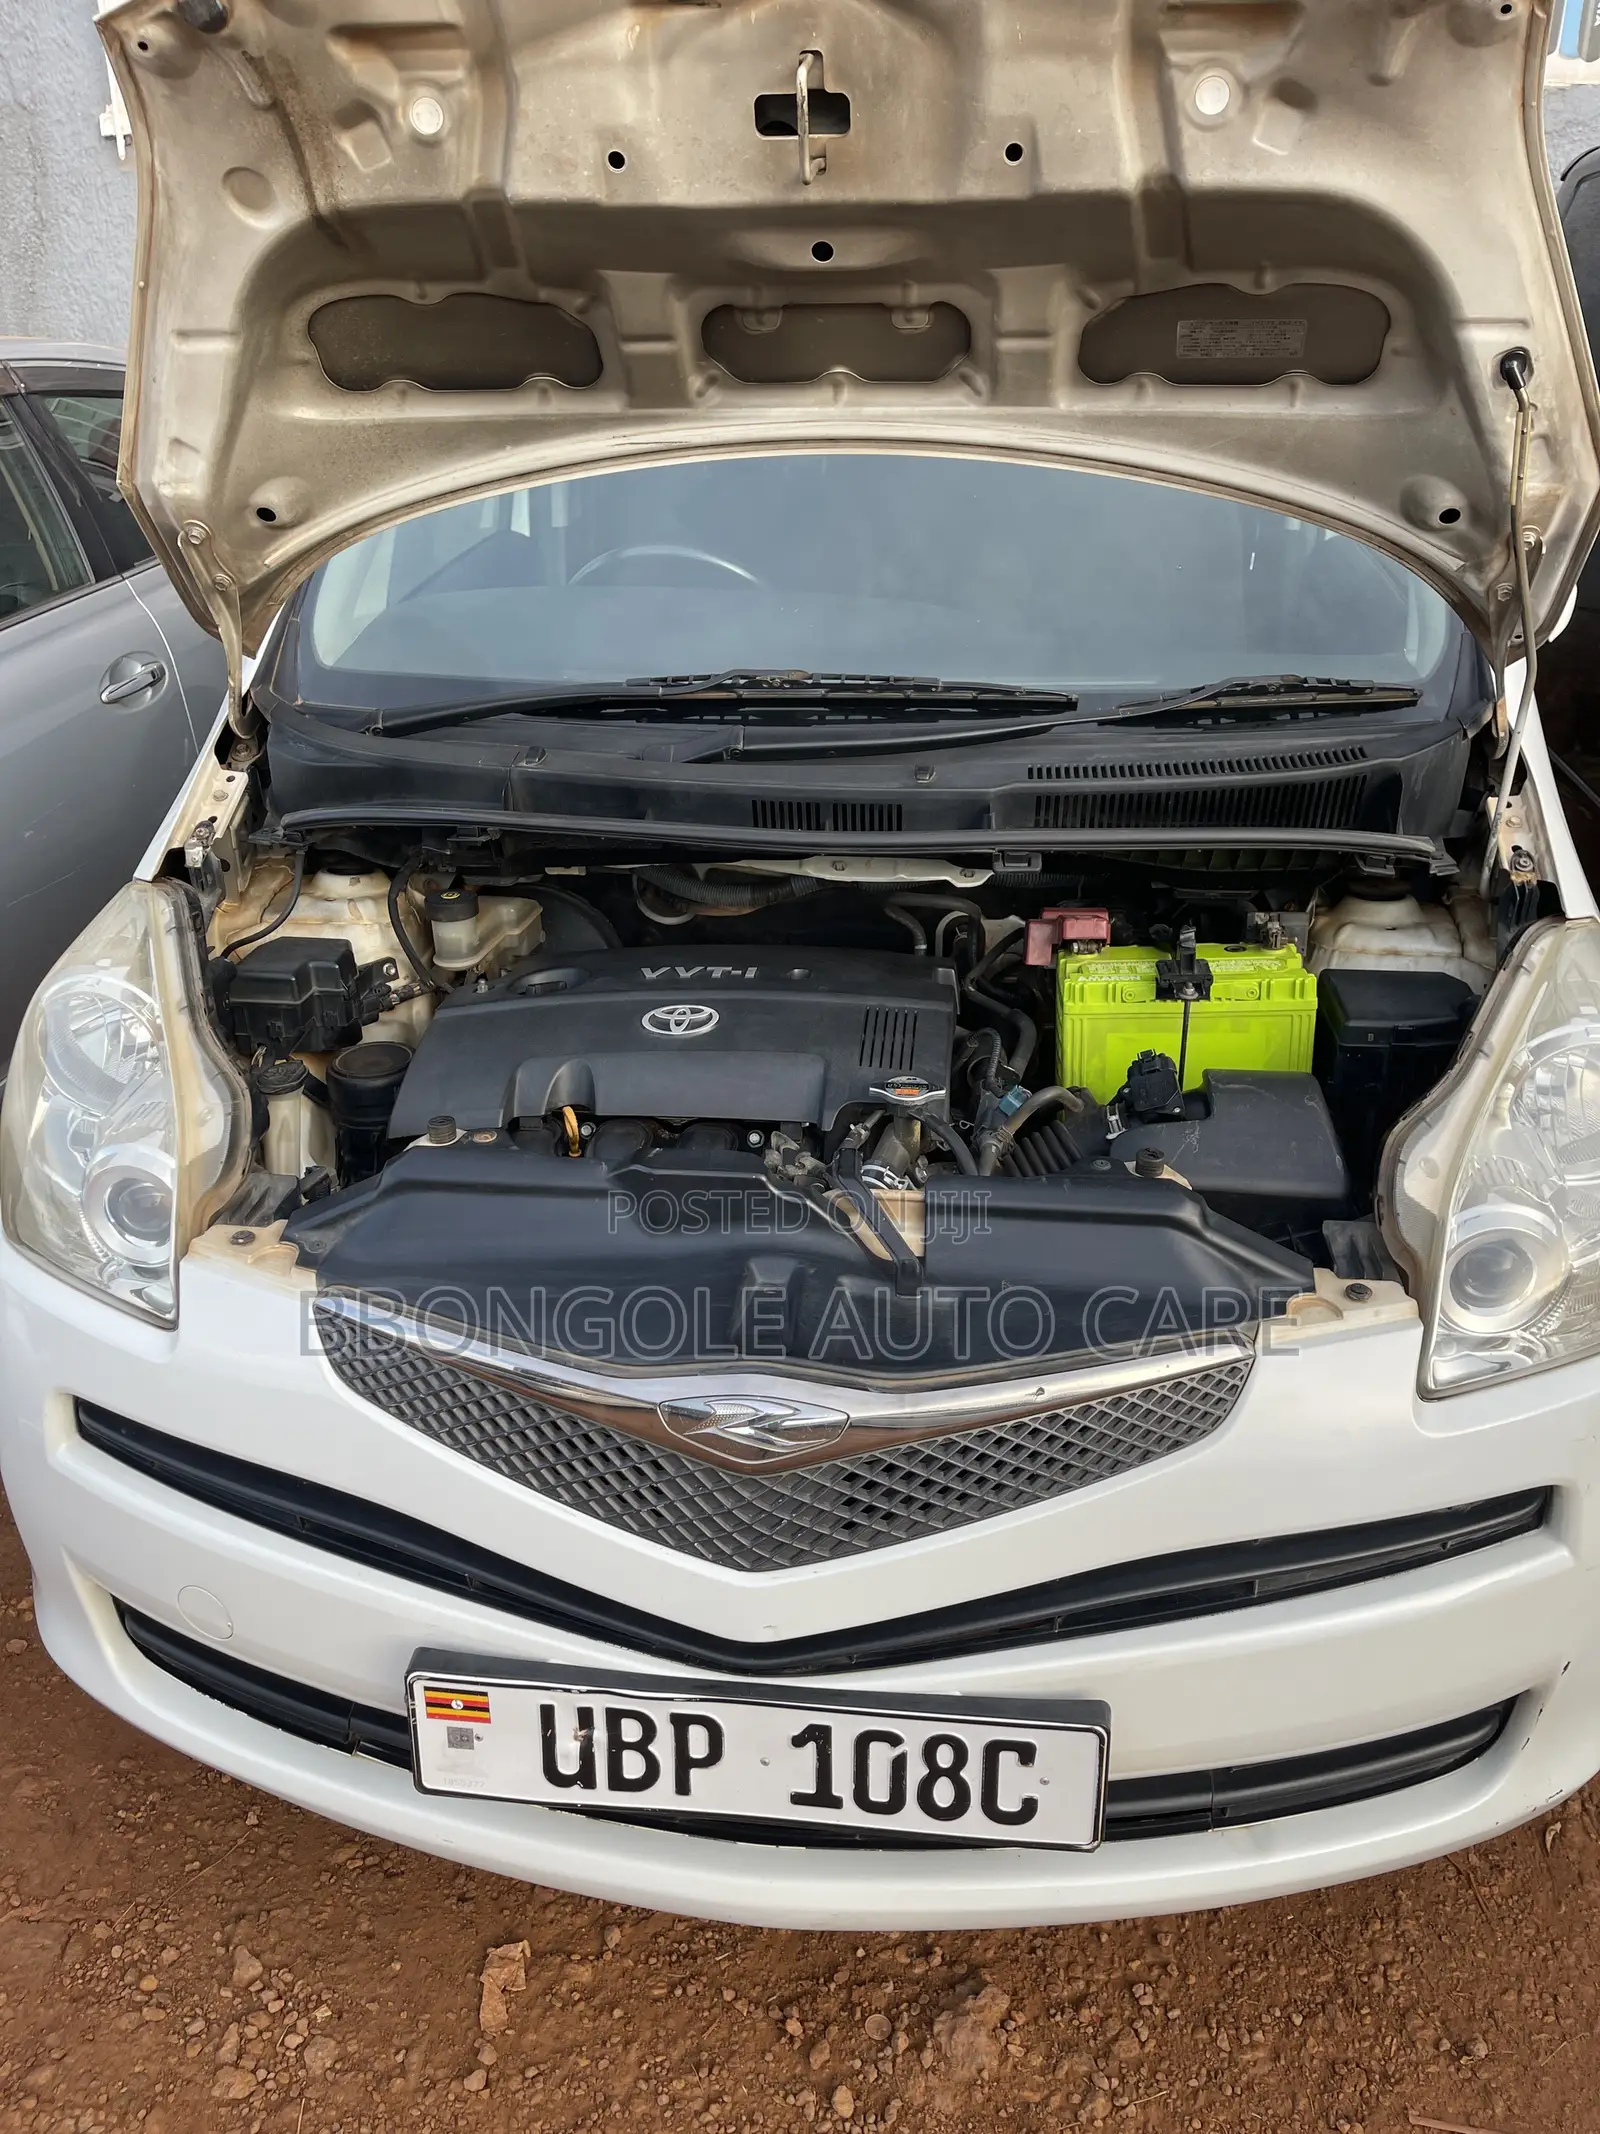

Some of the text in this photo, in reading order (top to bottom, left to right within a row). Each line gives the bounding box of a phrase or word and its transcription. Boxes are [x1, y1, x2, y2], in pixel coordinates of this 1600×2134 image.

[1077, 975, 1141, 983] AMARON
[538, 1703, 1039, 1825] UBP 108C
